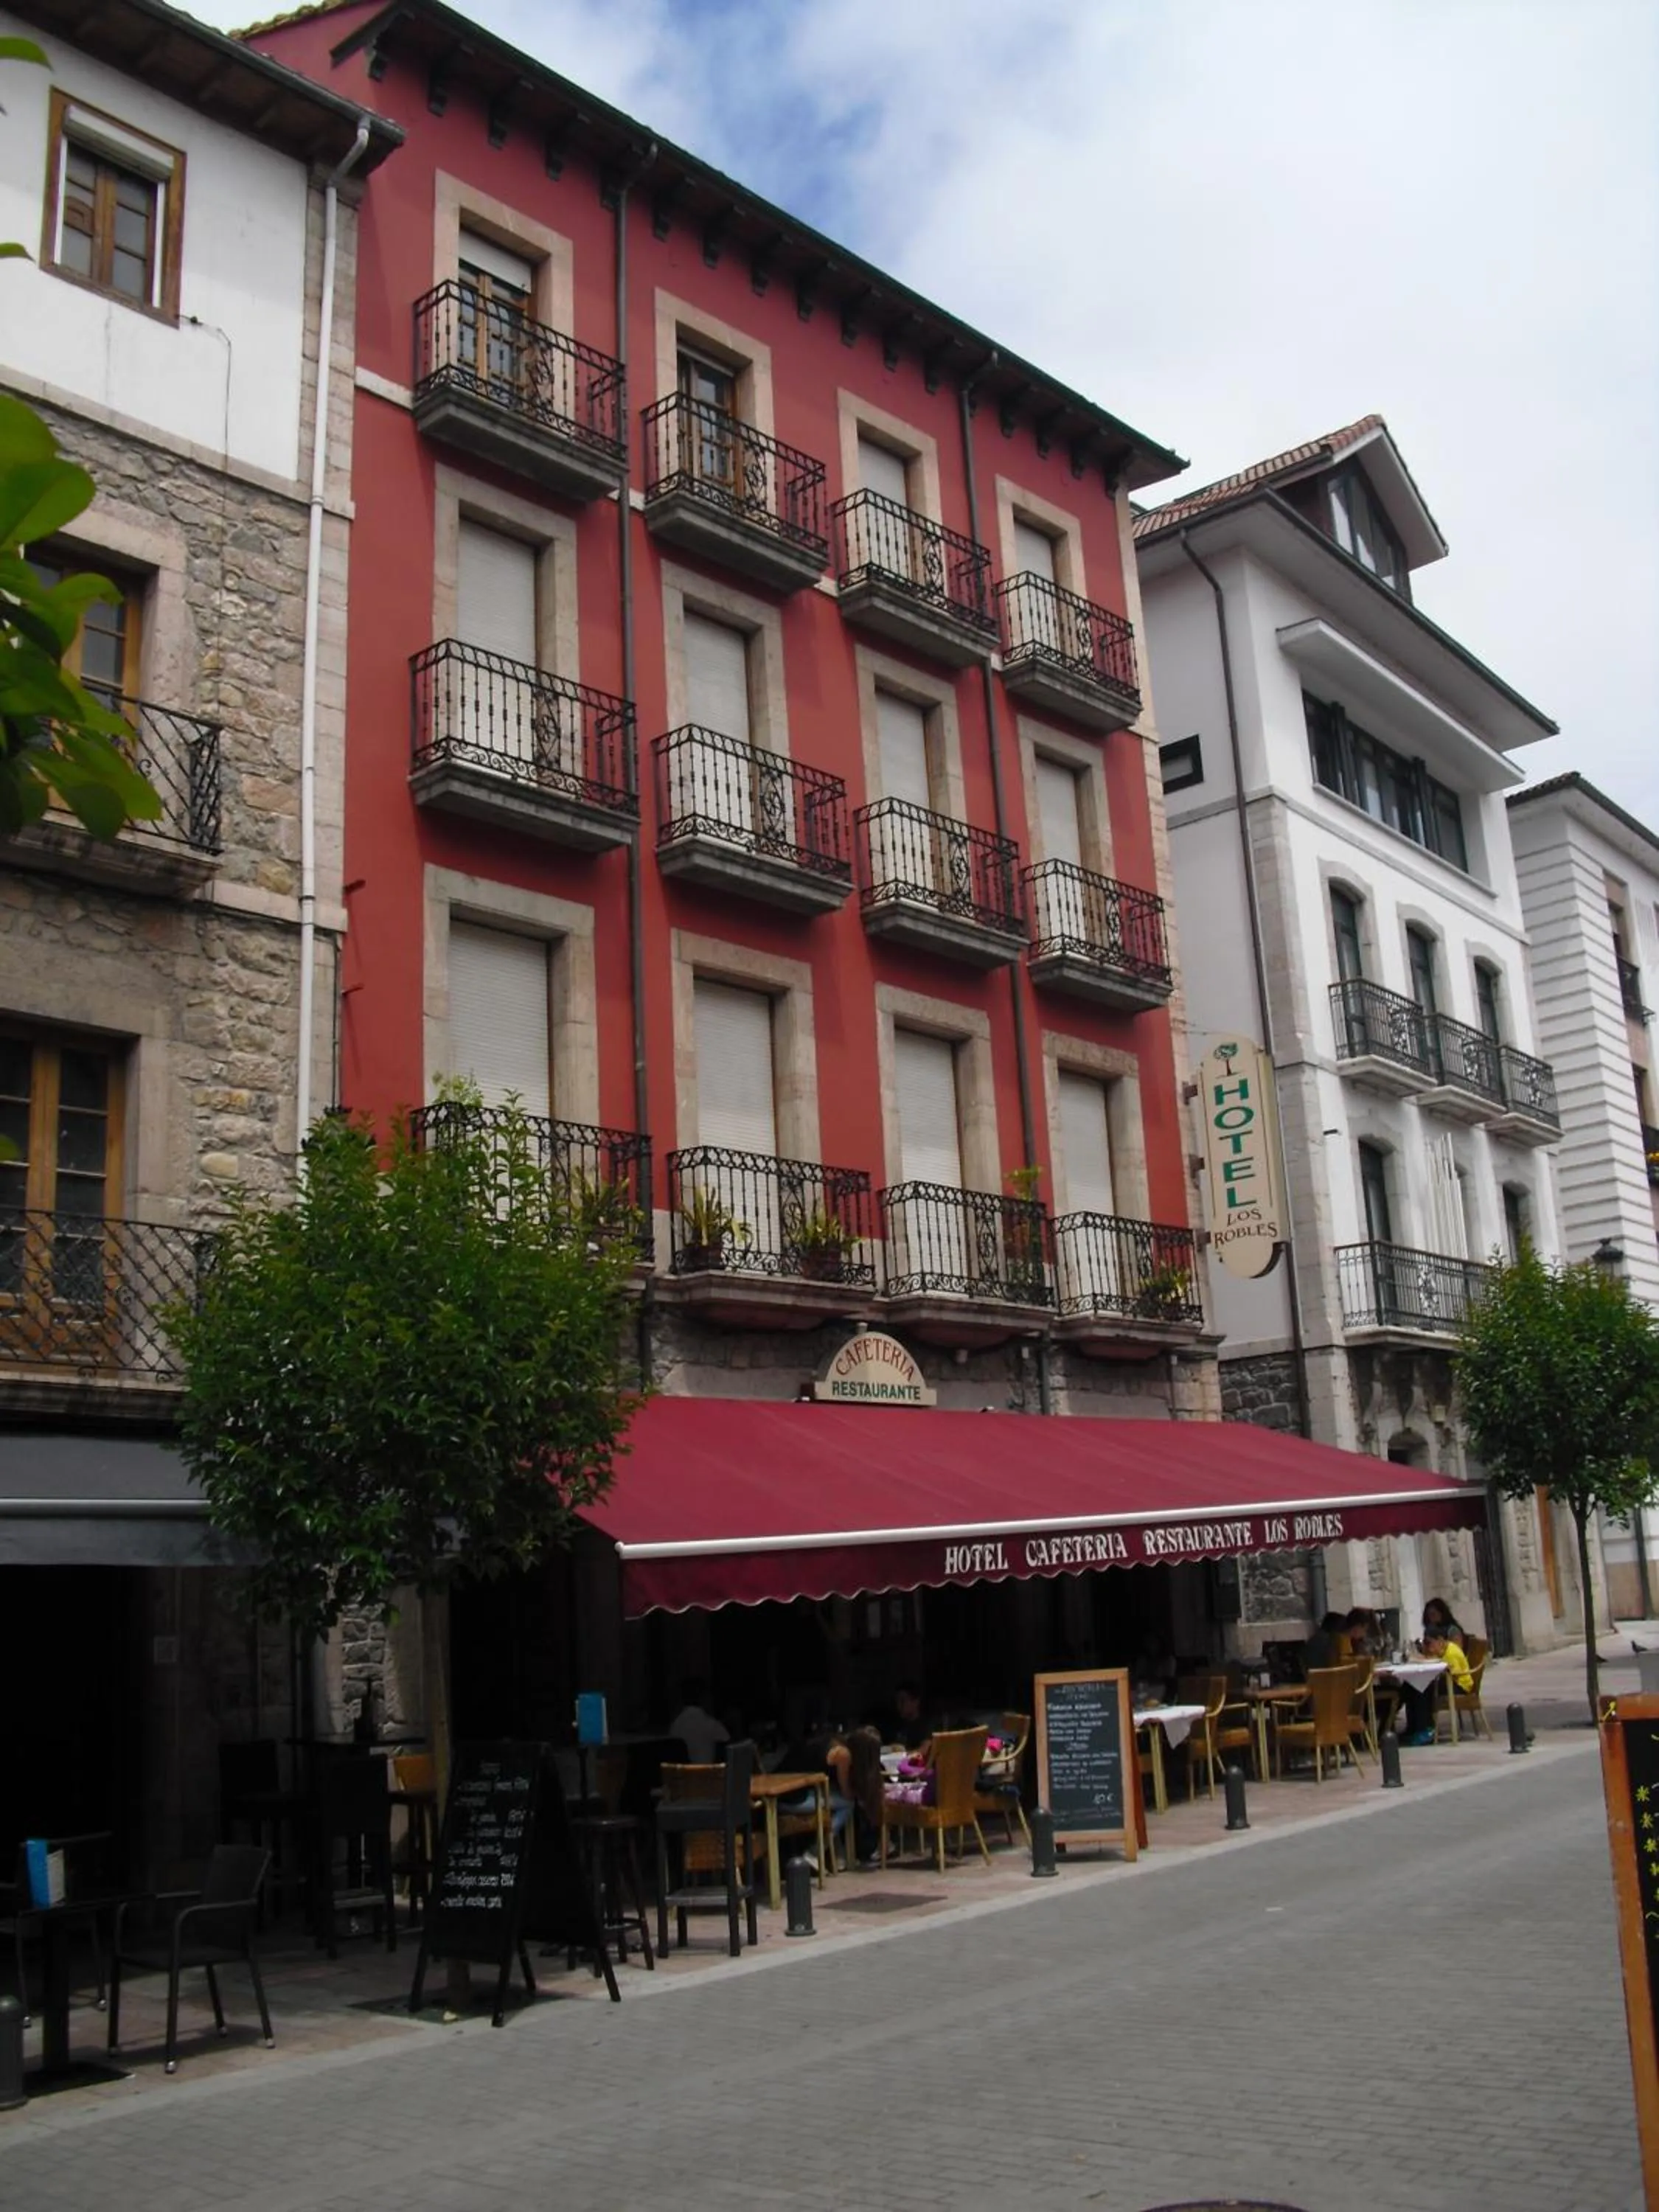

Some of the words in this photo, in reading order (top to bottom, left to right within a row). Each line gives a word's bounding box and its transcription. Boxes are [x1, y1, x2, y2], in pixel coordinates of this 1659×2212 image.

[1214, 1078, 1257, 1208] HOTEL
[1226, 1208, 1262, 1225] LOS
[1214, 1222, 1278, 1248] ROBLES
[835, 1338, 915, 1382] CAFETERIA
[832, 1380, 921, 1400] RESTAURANTE
[945, 1542, 1009, 1575] HOTEL
[1026, 1532, 1128, 1567] CAFETERIA
[1144, 1521, 1254, 1555] RESTAURANTE
[1264, 1518, 1289, 1543] LOS
[1294, 1513, 1344, 1540] ROBLES
